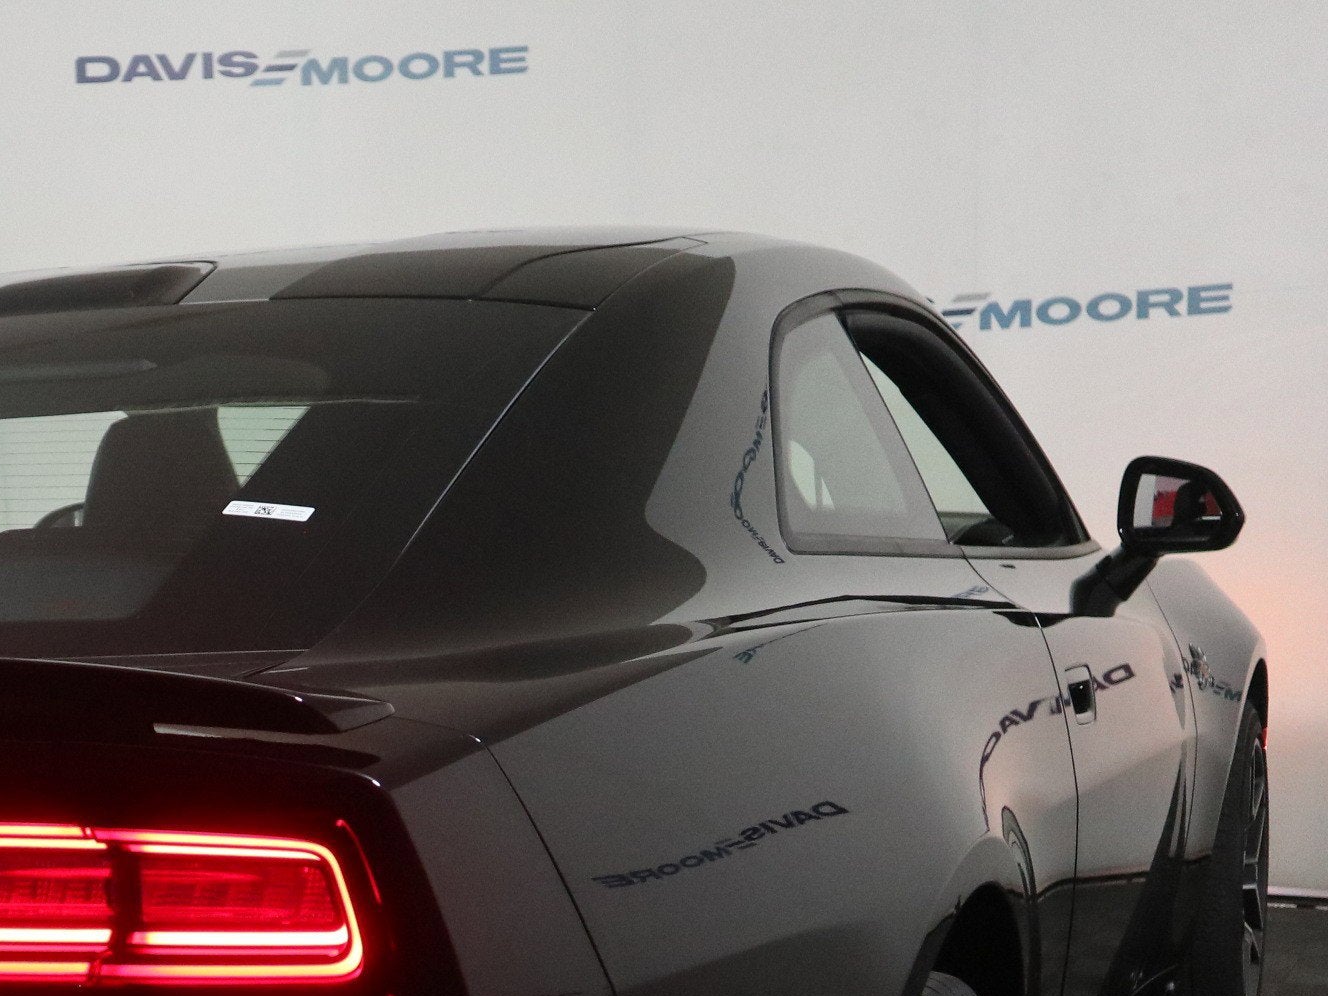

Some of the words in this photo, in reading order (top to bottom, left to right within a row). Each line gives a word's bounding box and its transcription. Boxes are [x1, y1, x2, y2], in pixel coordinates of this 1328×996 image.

[75, 51, 259, 84] DAVIS
[301, 46, 529, 86] MOORE
[979, 284, 1233, 331] MOORE
